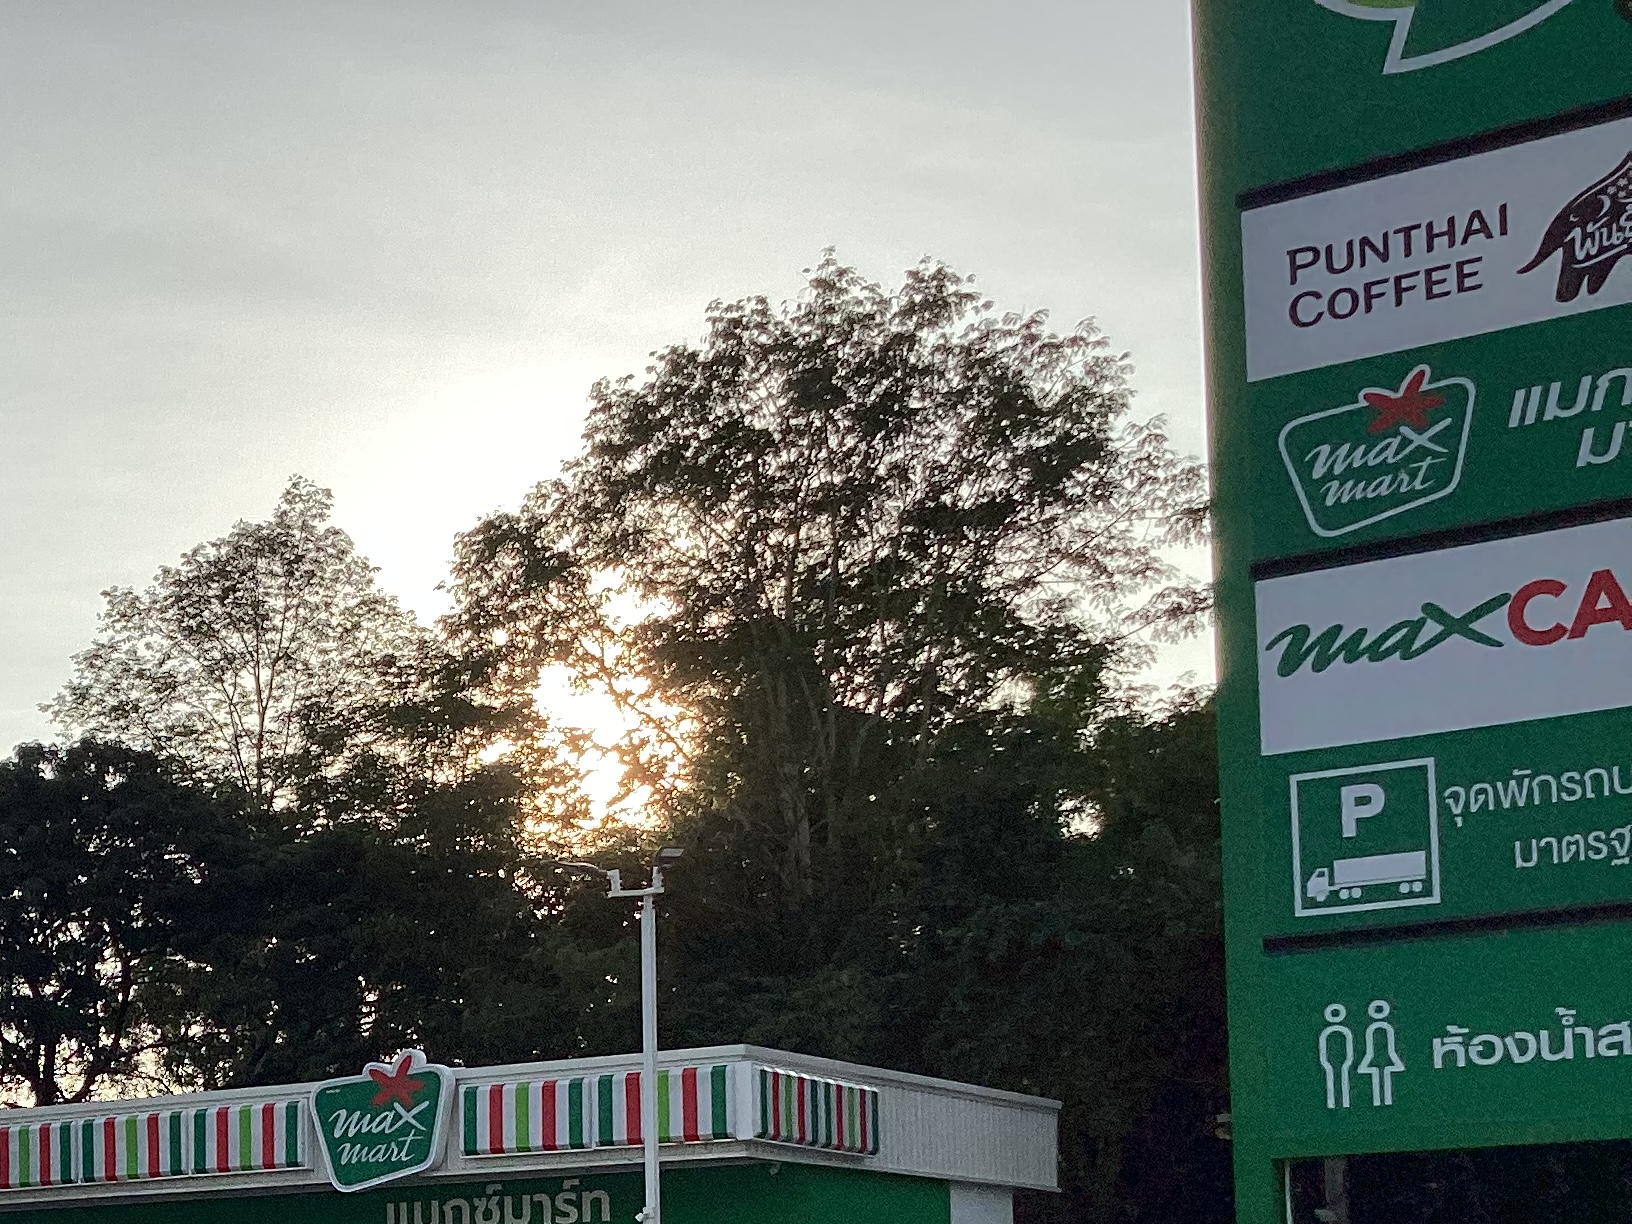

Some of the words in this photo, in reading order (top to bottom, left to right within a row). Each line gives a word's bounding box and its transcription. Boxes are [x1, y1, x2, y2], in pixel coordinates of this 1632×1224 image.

[1286, 202, 1508, 285] PUNTHAI
[1287, 256, 1483, 328] COFFEE
[1306, 419, 1449, 479] max
[1320, 456, 1446, 507] mart
[1340, 783, 1386, 838] P
[328, 1100, 430, 1139] max
[337, 1132, 424, 1166] mart
